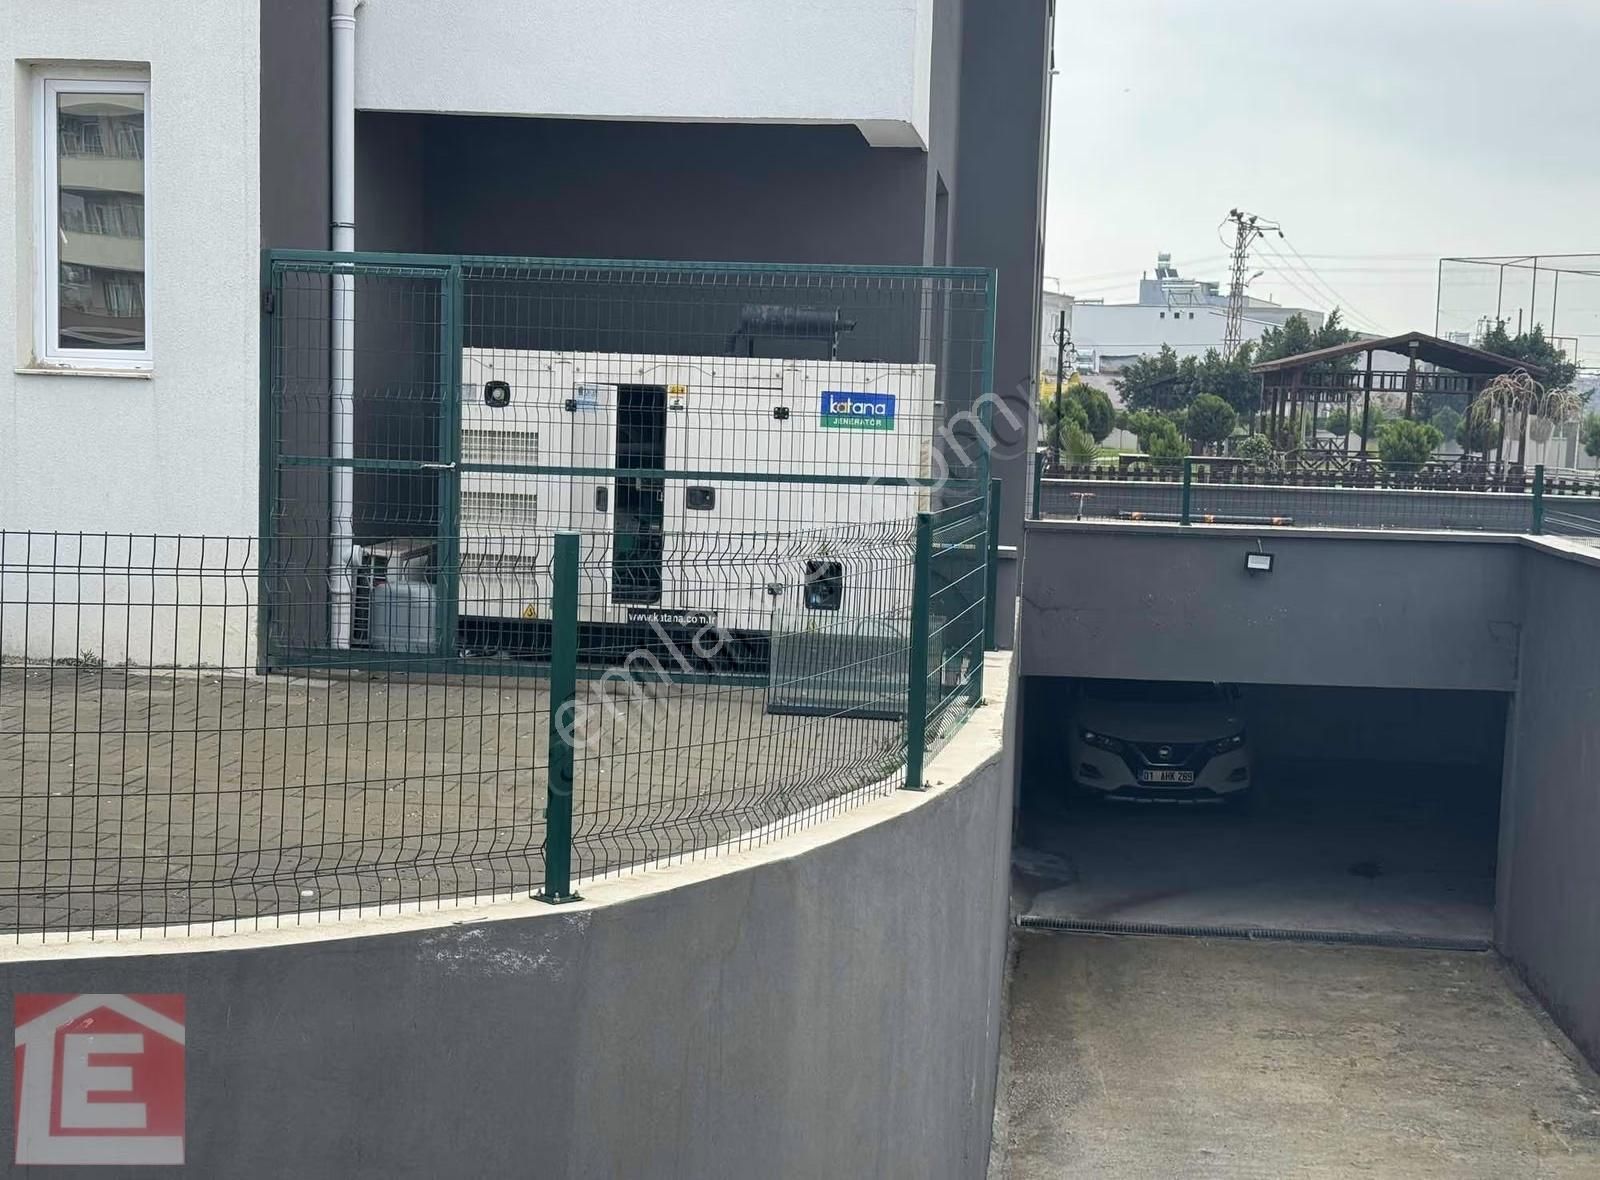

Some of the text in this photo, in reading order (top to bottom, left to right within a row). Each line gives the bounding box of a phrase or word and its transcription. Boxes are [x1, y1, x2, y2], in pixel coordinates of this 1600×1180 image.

[830, 394, 886, 415] katana
[1144, 771, 1153, 781] 01
[1160, 771, 1176, 781] AHK
